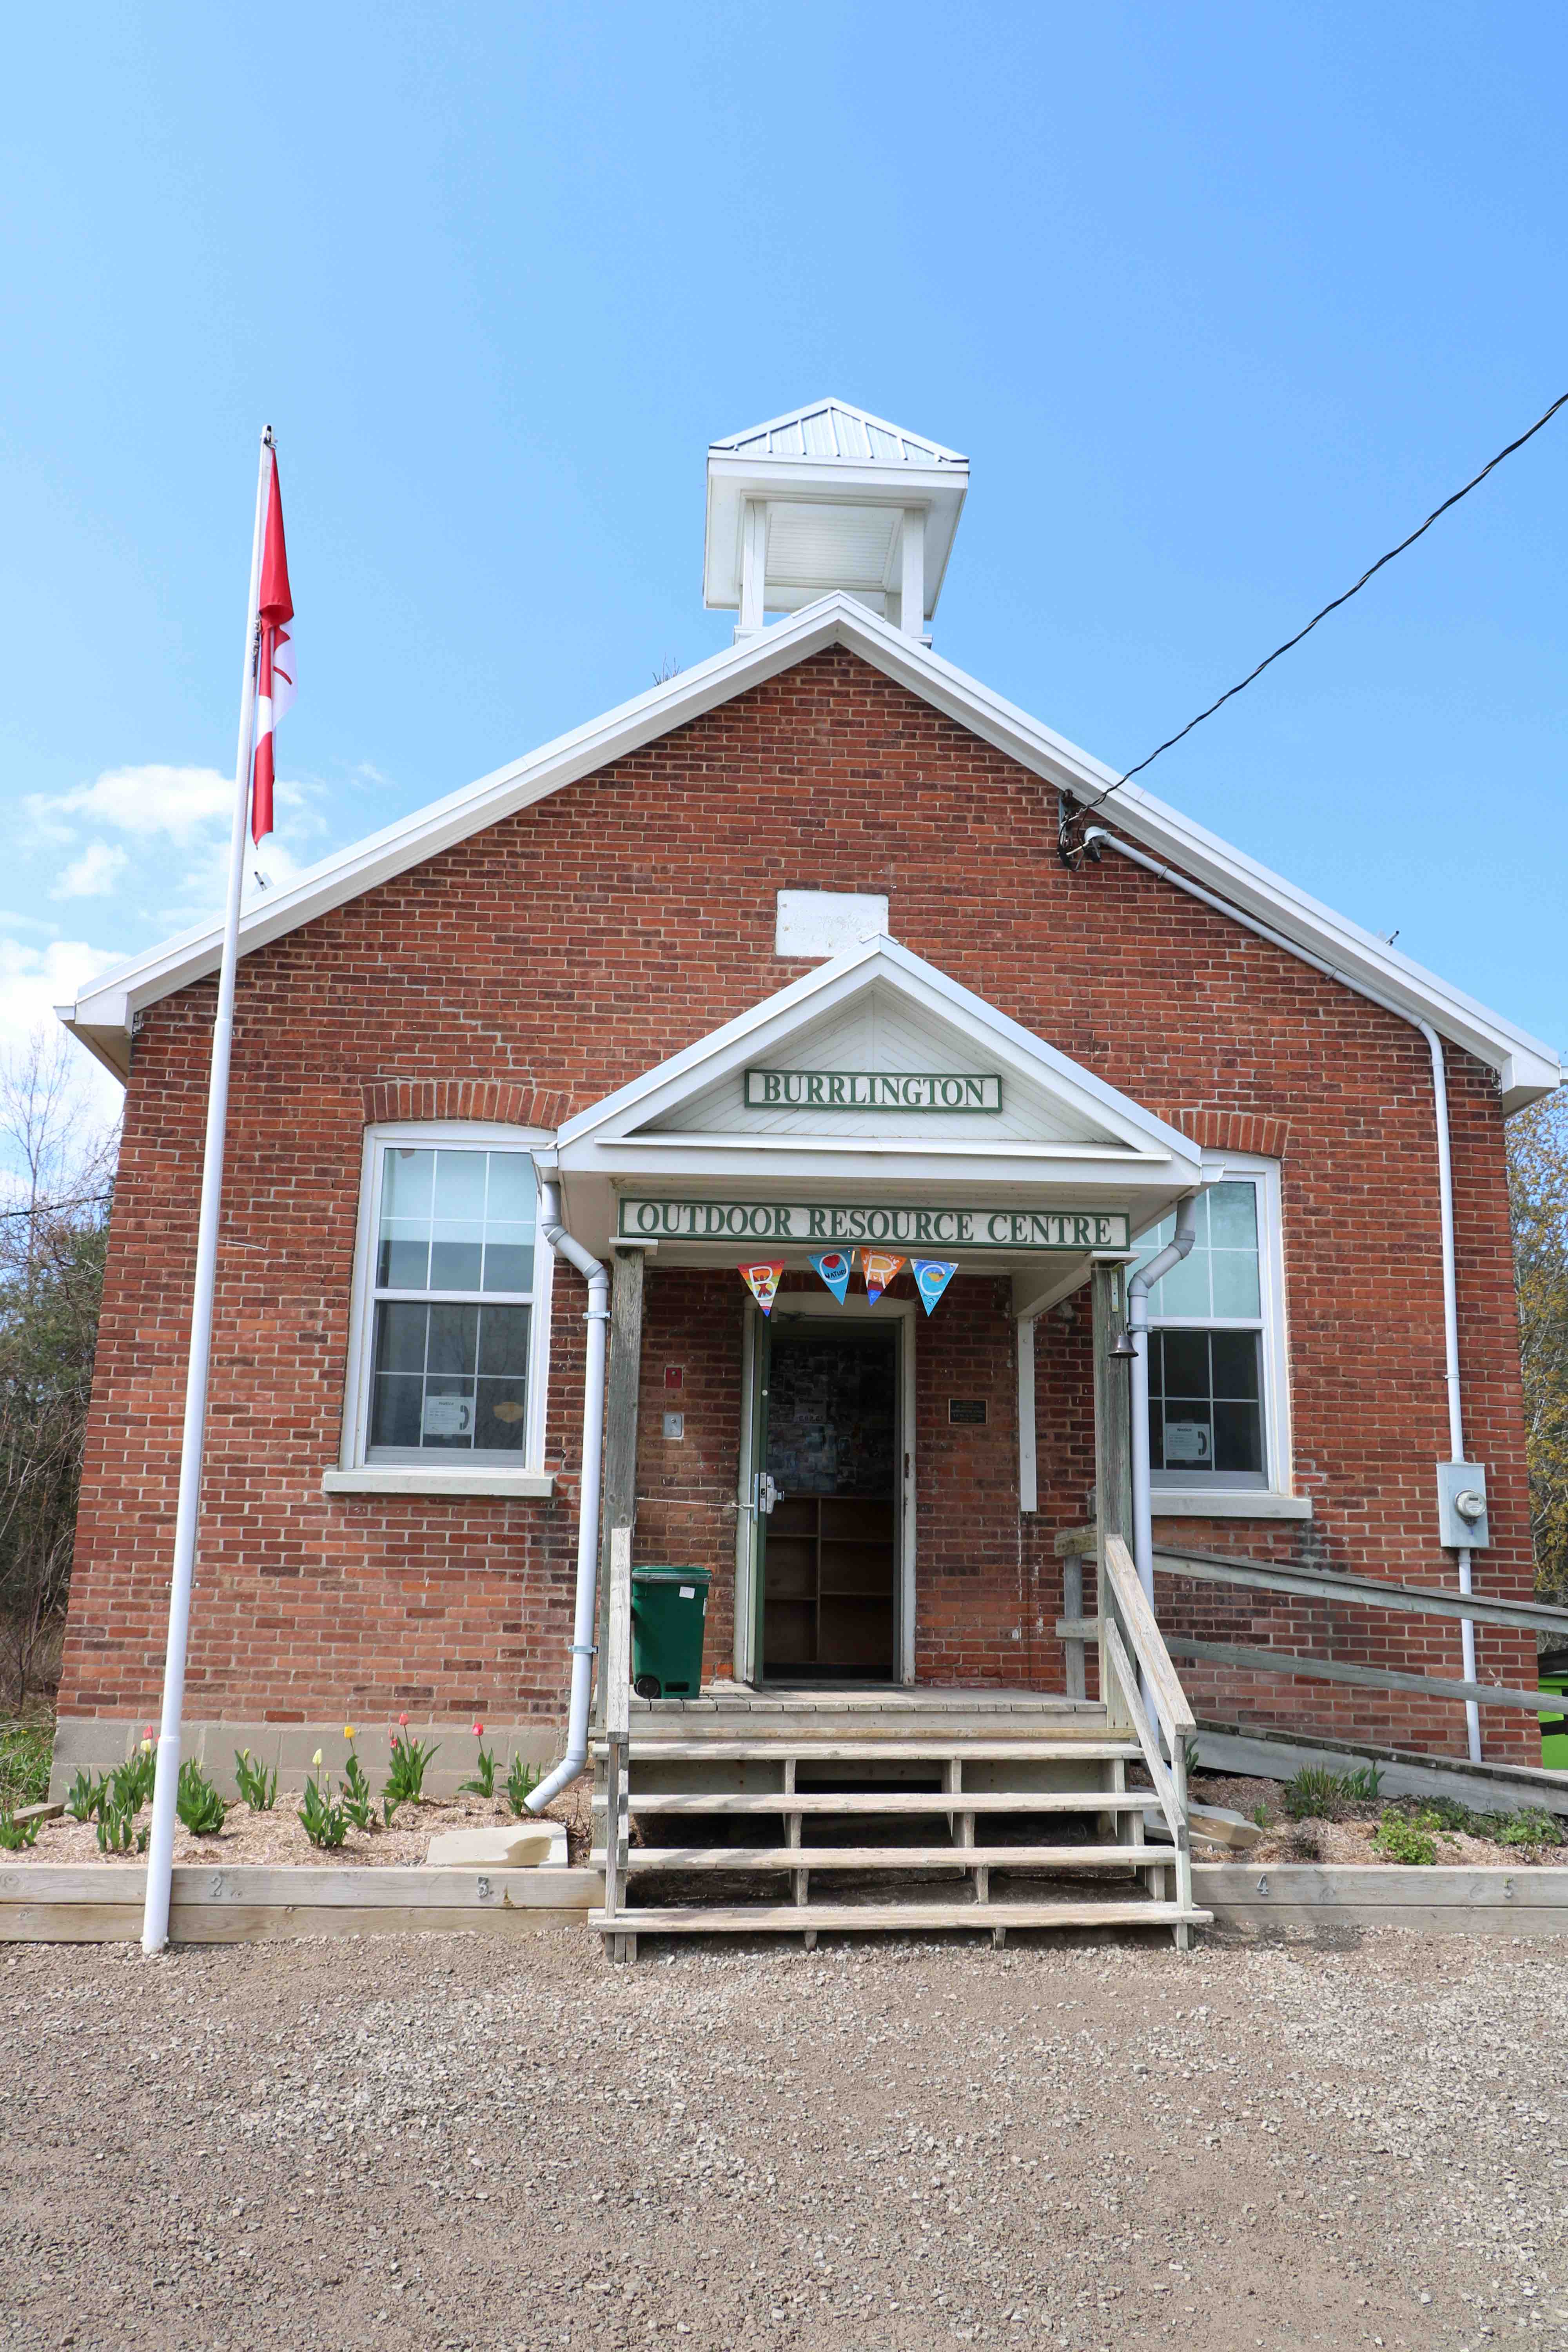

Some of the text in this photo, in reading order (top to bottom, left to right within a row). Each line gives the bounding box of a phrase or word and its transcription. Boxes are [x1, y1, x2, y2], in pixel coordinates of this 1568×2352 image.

[762, 1074, 985, 1106] BURRLINGTON
[637, 1203, 1112, 1245] OUTDOOR RESOURCE CENTRE
[749, 1266, 776, 1300] B
[1257, 1873, 1269, 1895] 4
